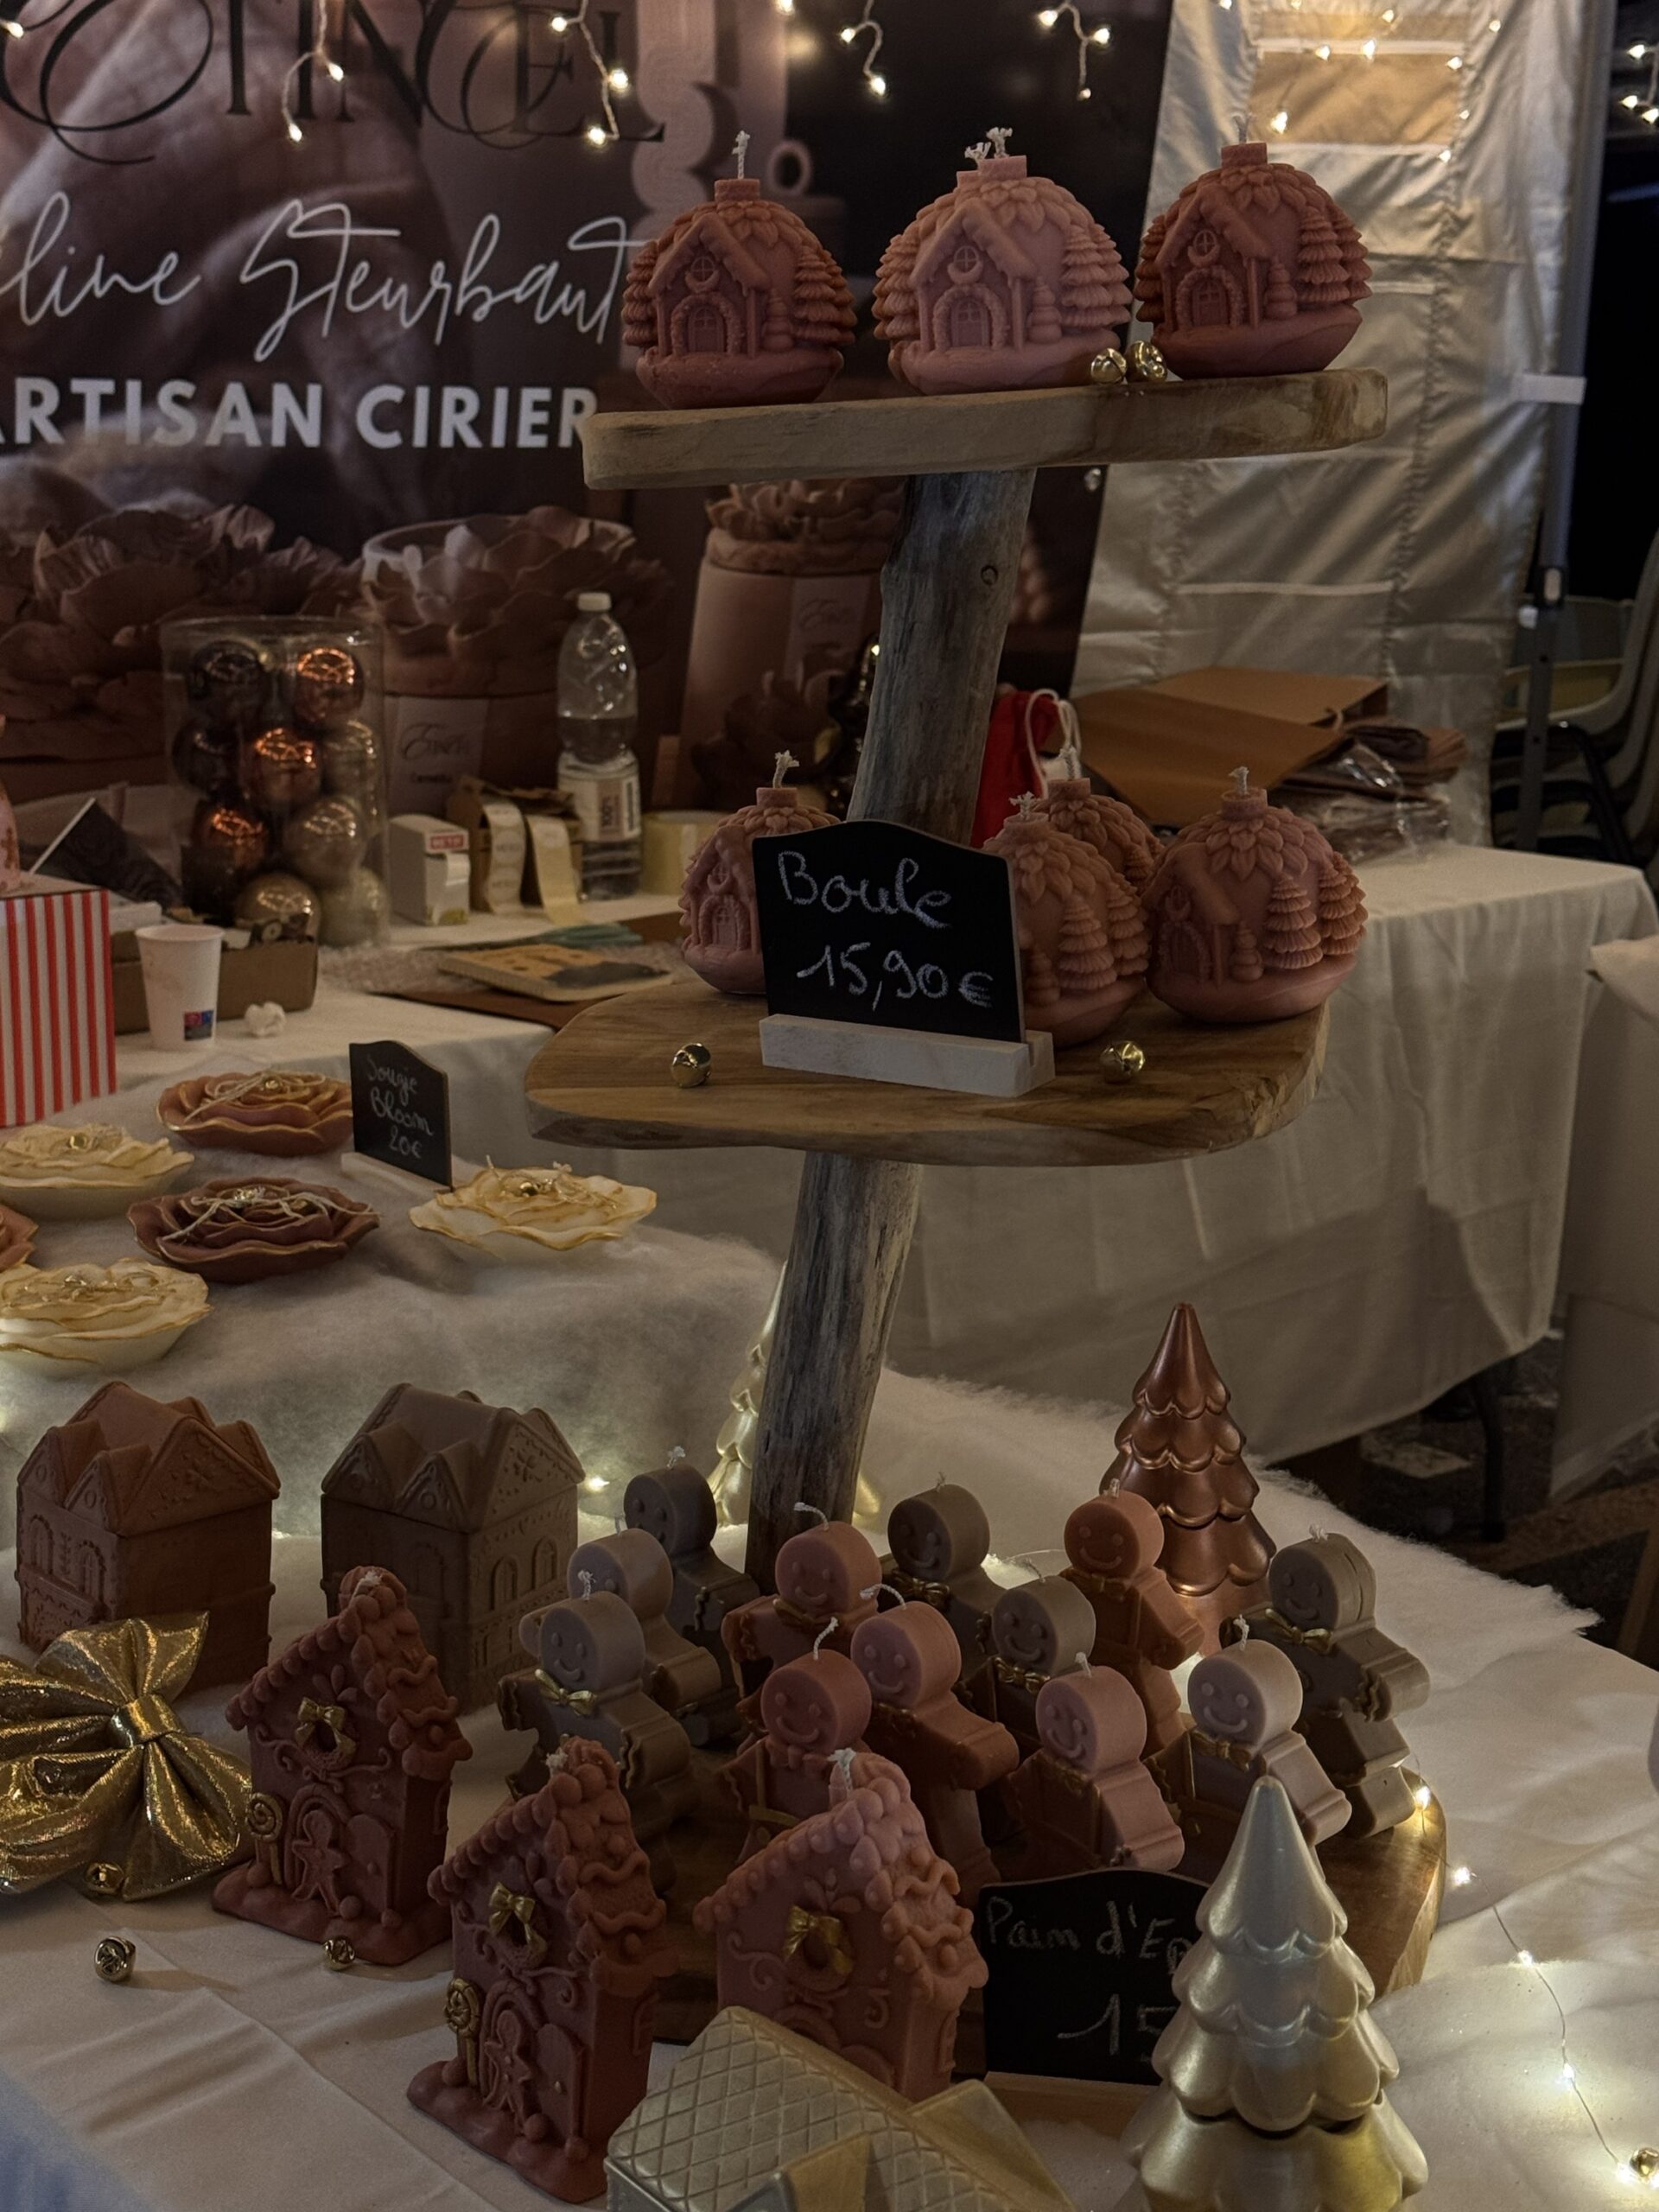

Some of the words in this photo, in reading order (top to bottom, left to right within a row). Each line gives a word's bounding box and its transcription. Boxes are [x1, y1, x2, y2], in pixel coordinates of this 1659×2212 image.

[0, 191, 201, 327] line
[0, 376, 323, 448] RTISAN
[355, 385, 598, 448] CIRIER
[777, 850, 953, 929] Boule
[796, 940, 995, 1013] 15,90€
[370, 1085, 434, 1136] Bloom
[389, 1125, 423, 1159] 20€
